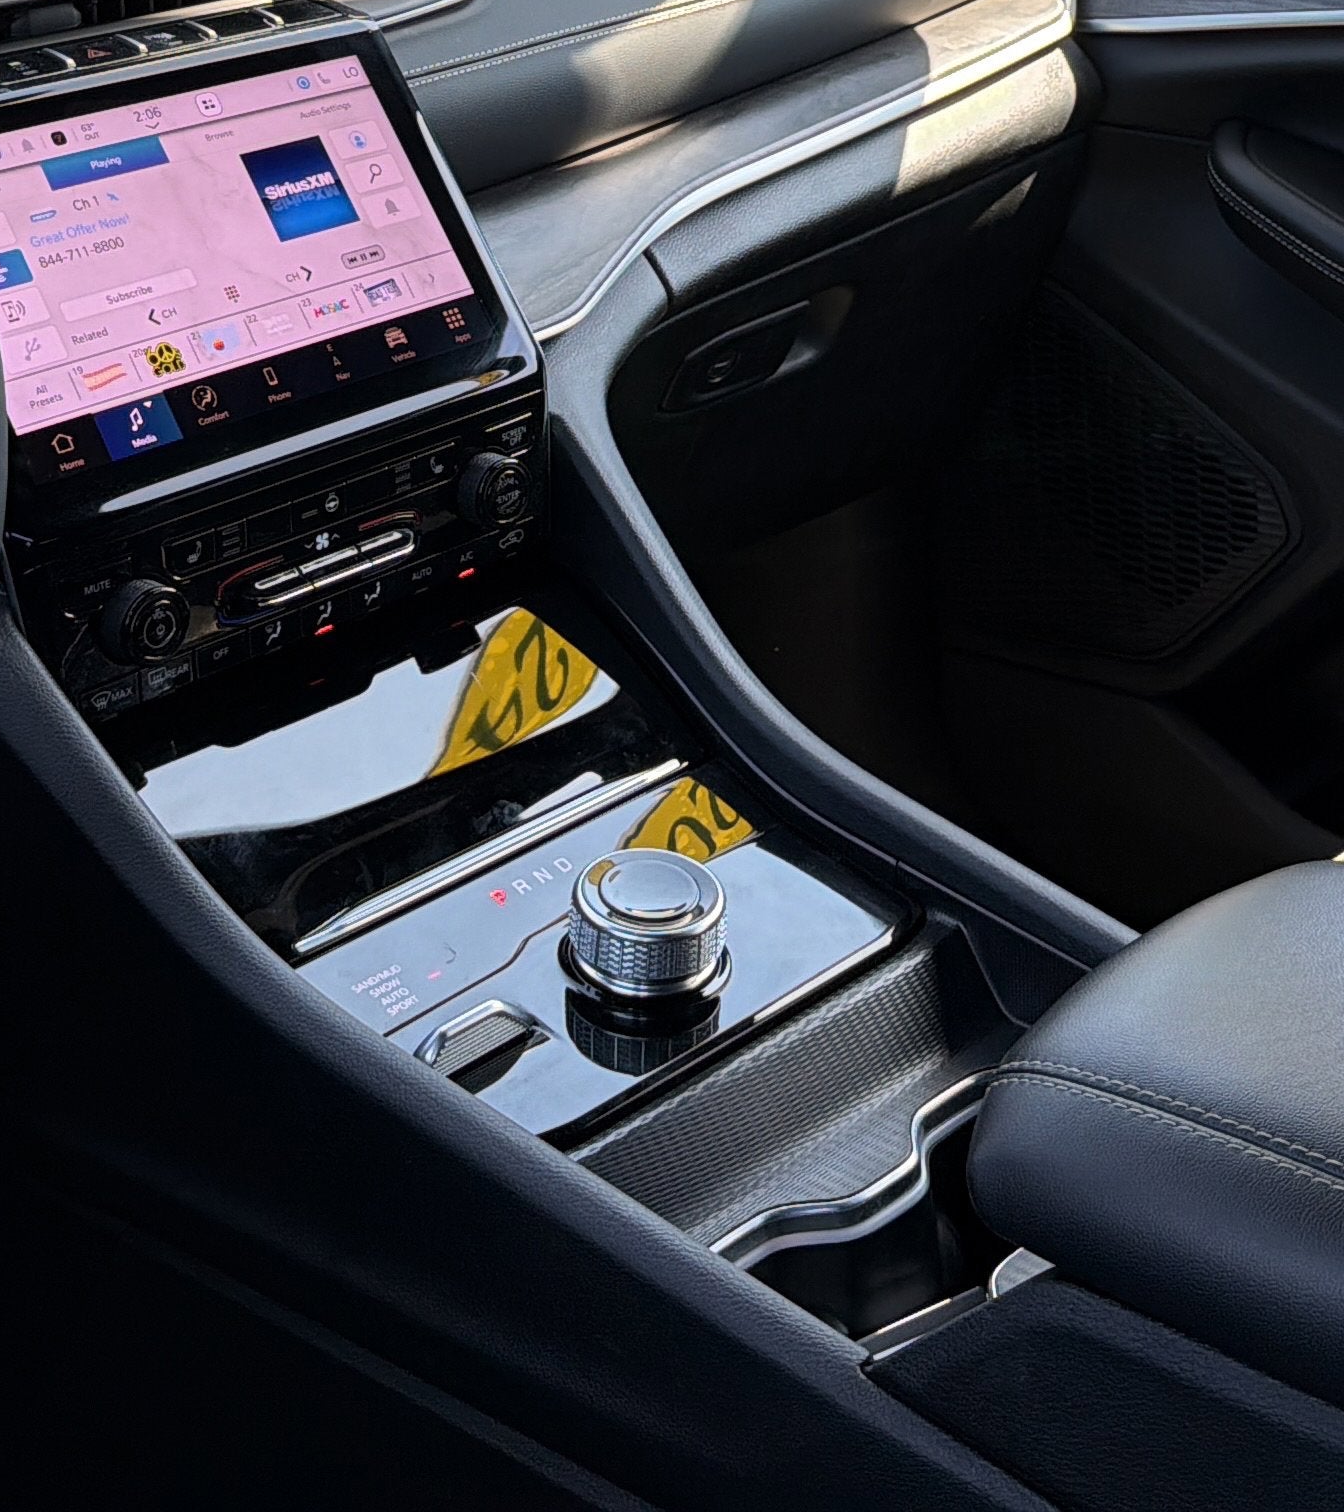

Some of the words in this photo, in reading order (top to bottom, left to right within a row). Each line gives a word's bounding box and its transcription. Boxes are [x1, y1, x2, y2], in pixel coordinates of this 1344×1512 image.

[133, 107, 163, 123] 2:06
[299, 108, 323, 120] Audio
[321, 102, 353, 115] Settings
[84, 130, 101, 141] OUT
[204, 130, 236, 143] Browse
[89, 155, 123, 171] Playing
[264, 171, 337, 200] SiriusXM
[72, 197, 92, 212] Ch
[29, 232, 65, 248] Great
[65, 225, 97, 239] Offer
[98, 214, 130, 231] Now!
[38, 236, 126, 268] 844-711-8800
[285, 272, 301, 284] CH
[106, 286, 154, 305] Subscribe
[161, 307, 178, 319] CH
[71, 328, 109, 345] Related
[72, 365, 85, 377] 19
[35, 384, 48, 395] All
[29, 394, 64, 409] Presets
[267, 391, 292, 404] Phone
[198, 410, 230, 426] Comfort
[501, 424, 527, 442] SCREEN
[131, 434, 158, 448] Media
[59, 458, 86, 471] Home
[459, 550, 474, 563] A/C
[411, 566, 433, 581] AUTO
[84, 579, 112, 595] MUTE
[212, 646, 230, 660] OFF
[167, 663, 190, 678] REAR
[111, 687, 134, 702] MAX
[512, 879, 532, 895] R
[532, 868, 554, 885] N
[553, 857, 573, 873] D
[369, 977, 401, 998] SNOW
[380, 987, 410, 1007] AUTO
[387, 996, 419, 1017] SPORT
